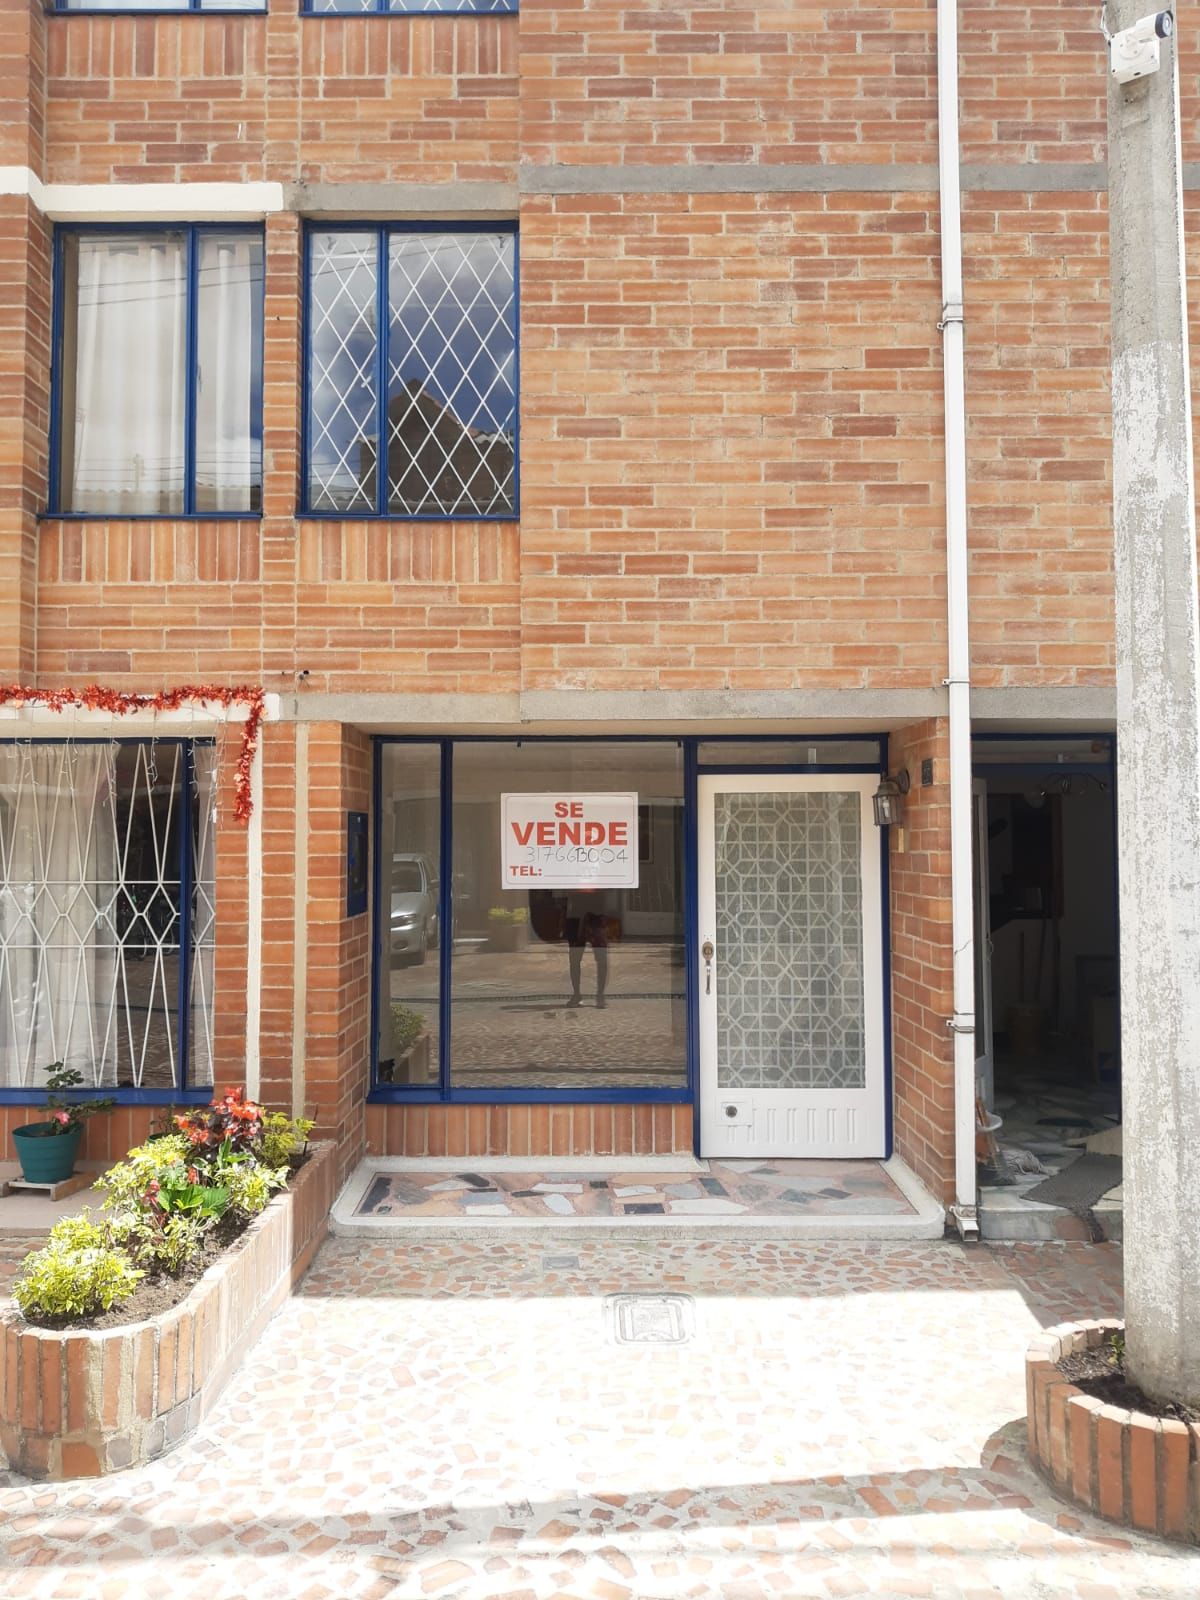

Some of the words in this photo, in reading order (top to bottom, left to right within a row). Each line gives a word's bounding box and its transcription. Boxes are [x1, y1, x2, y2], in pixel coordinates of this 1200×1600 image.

[554, 801, 583, 818] SE
[511, 822, 628, 846] VENDE
[510, 865, 542, 876] TEL:
